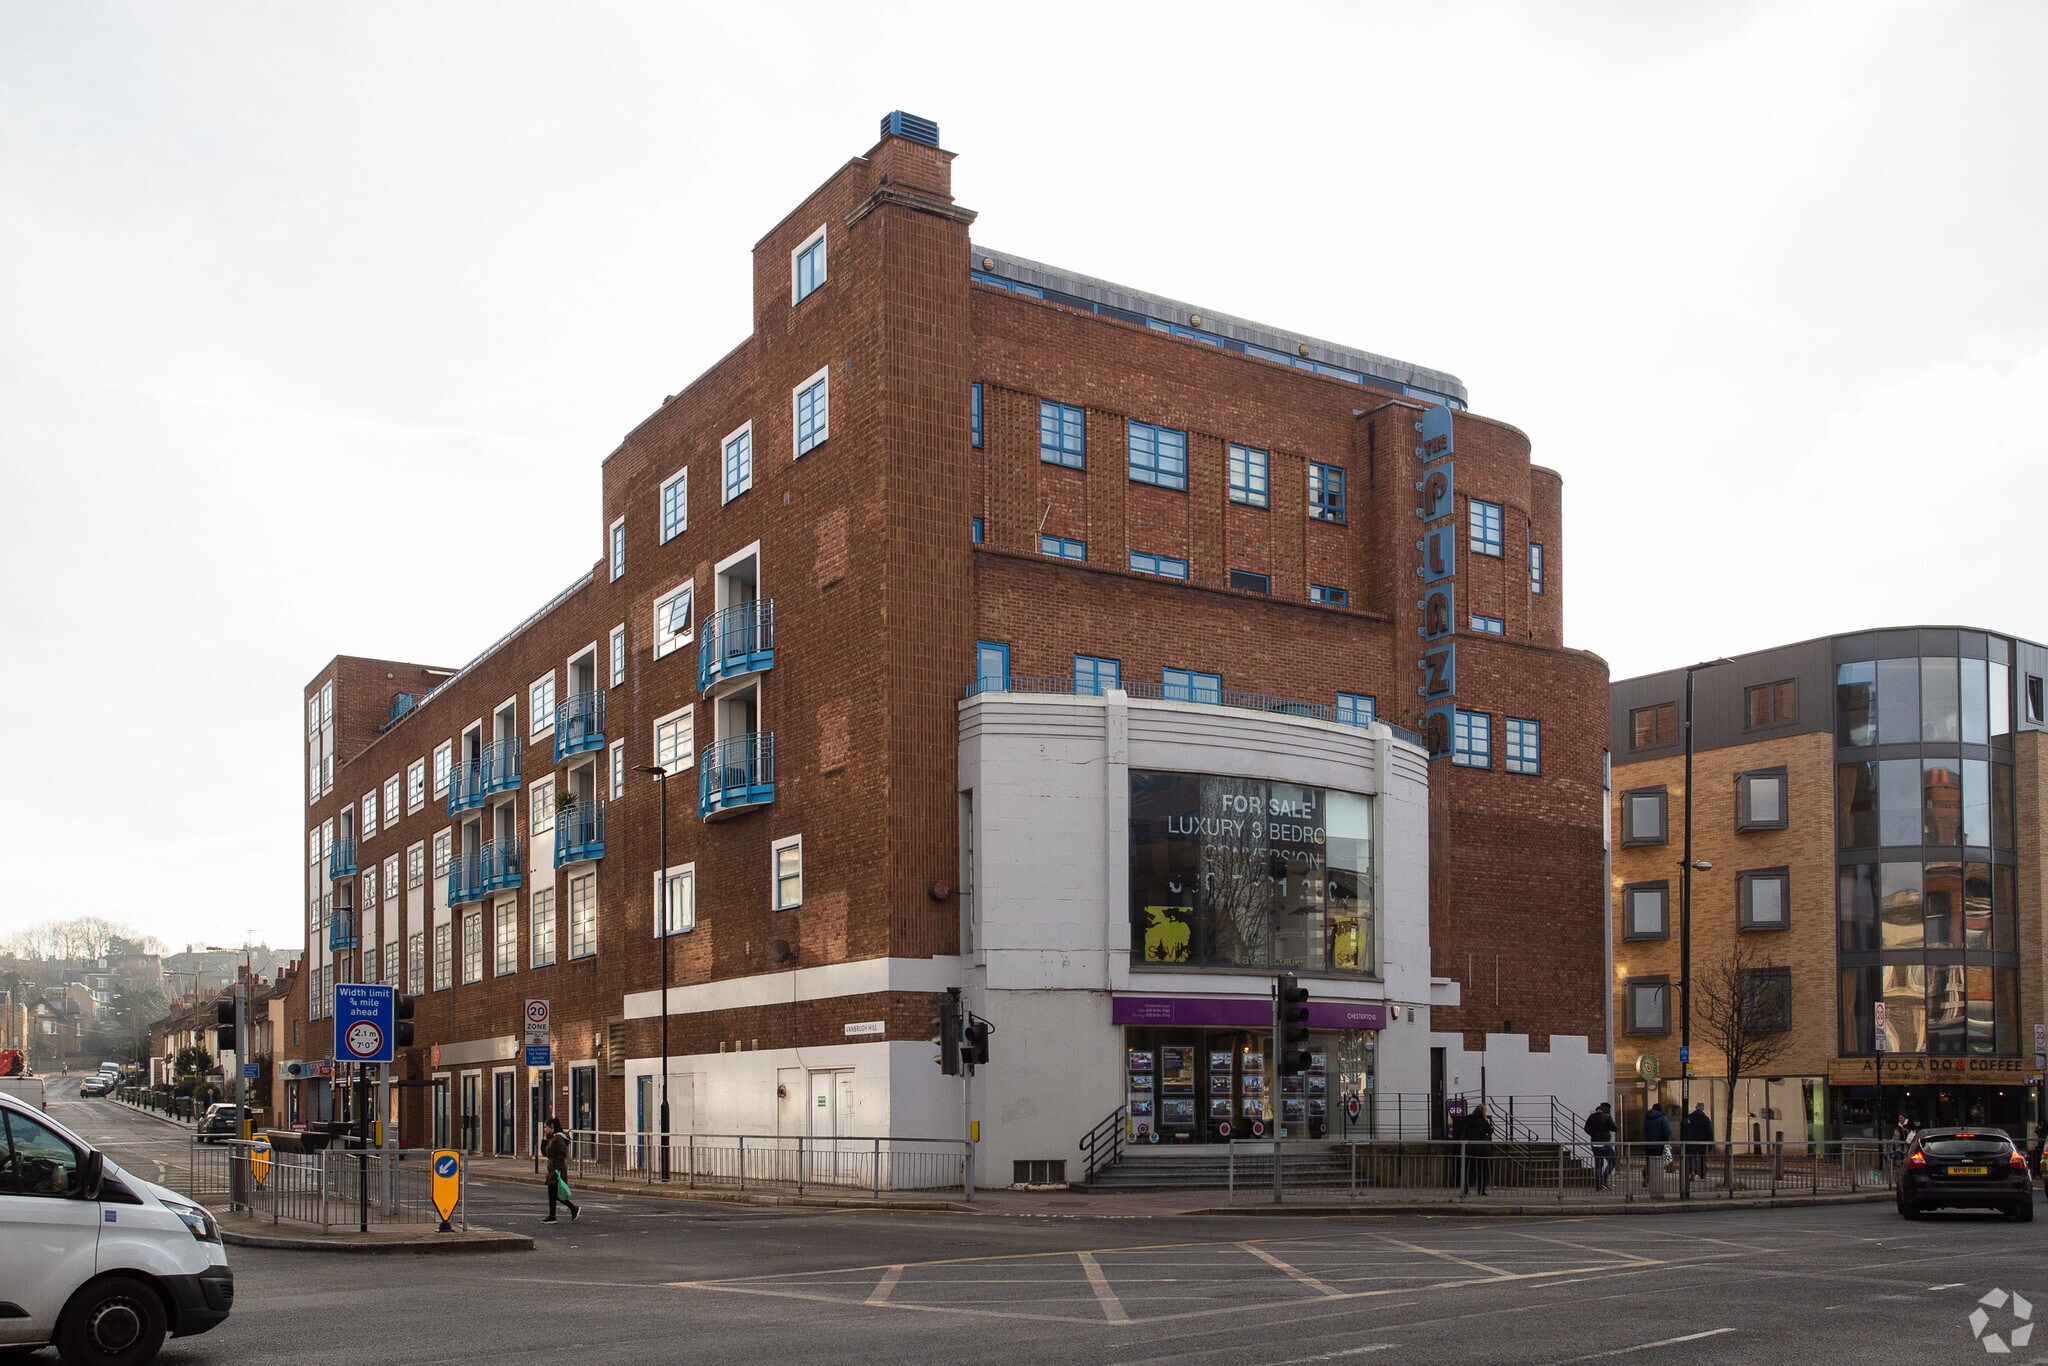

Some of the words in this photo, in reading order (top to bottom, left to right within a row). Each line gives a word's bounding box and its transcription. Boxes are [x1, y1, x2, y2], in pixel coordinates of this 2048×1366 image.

[1424, 434, 1448, 456] THE
[1222, 794, 1261, 814] FOR
[1269, 798, 1312, 819] SALE
[1168, 816, 1244, 837] LUXURY
[1252, 821, 1262, 839] 3
[340, 988, 366, 997] Width
[369, 989, 390, 998] limit
[360, 999, 379, 1007] mile
[350, 1008, 379, 1016] ahead
[530, 1006, 545, 1016] 20
[1347, 1013, 1377, 1021] CHESTERTONS
[354, 1028, 367, 1037] 2.1
[1969, 1060, 2022, 1072] COFFEE
